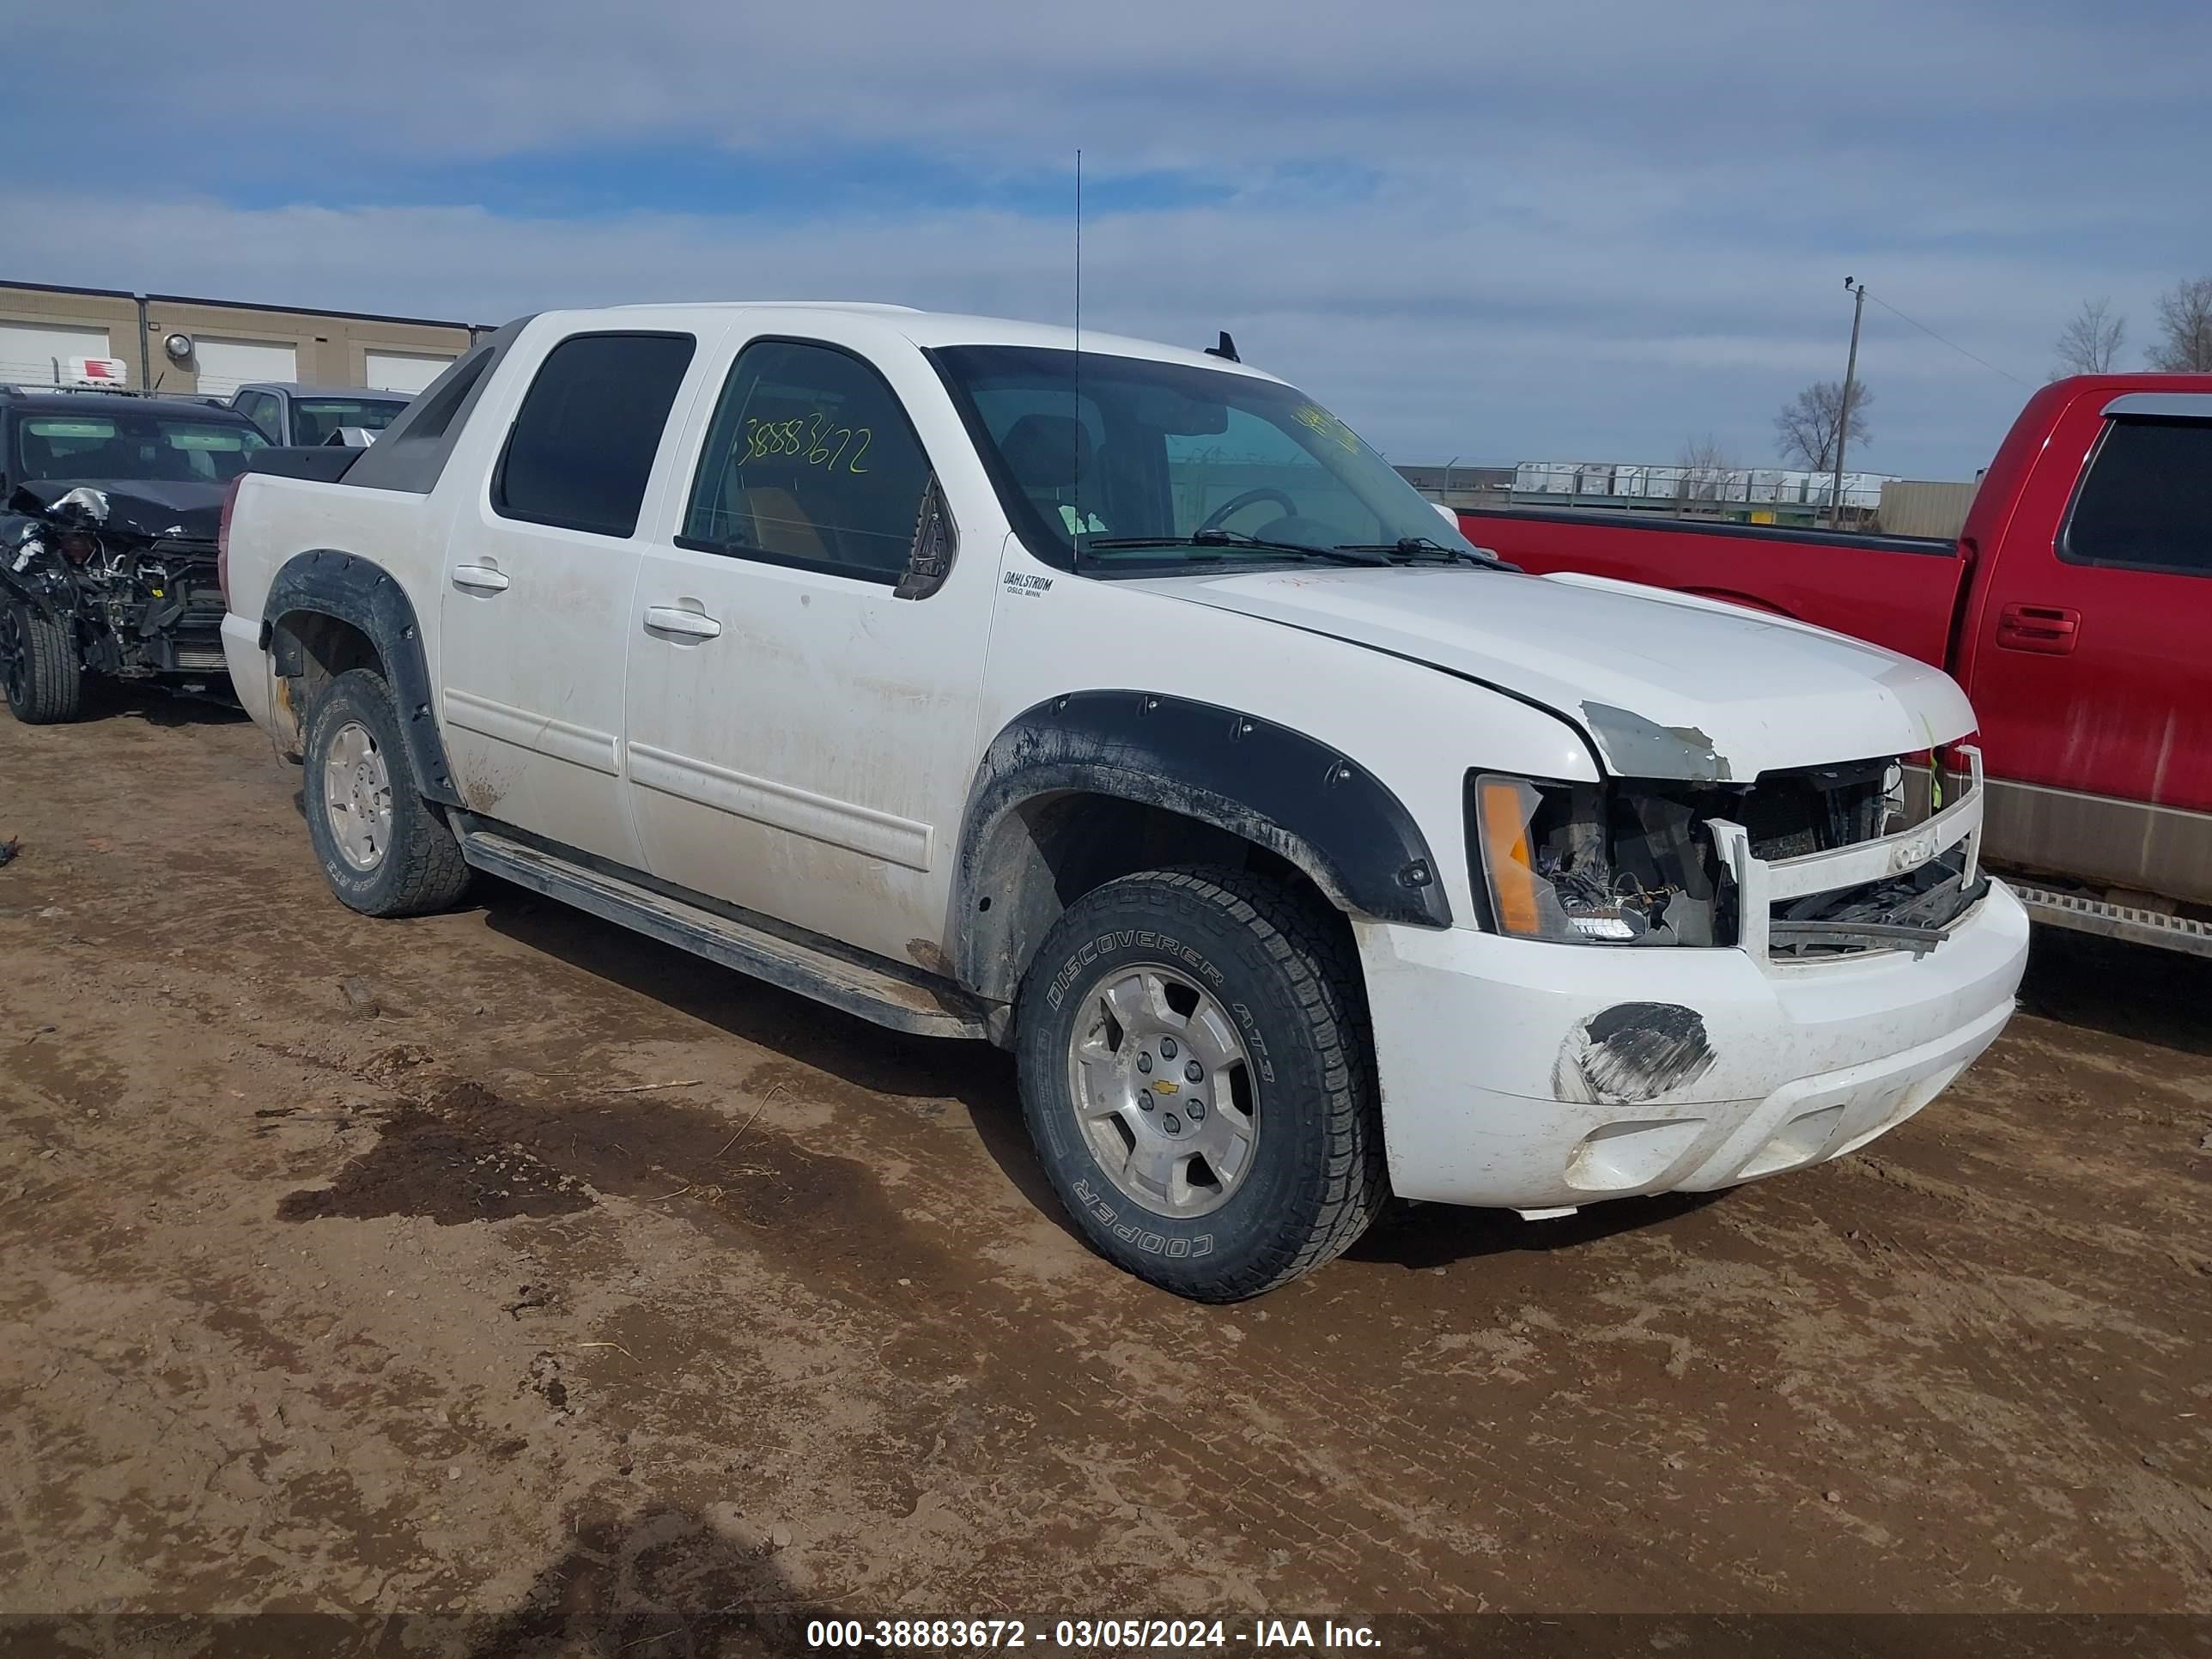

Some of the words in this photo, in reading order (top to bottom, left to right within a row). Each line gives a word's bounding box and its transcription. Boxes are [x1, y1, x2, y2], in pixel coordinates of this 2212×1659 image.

[737, 412, 872, 473] 38883672
[1003, 571, 1054, 592] DAHLSTROM
[309, 699, 350, 762] COOPER
[1046, 930, 1224, 1011] DISCOVERER
[1073, 1178, 1213, 1258] COOPER
